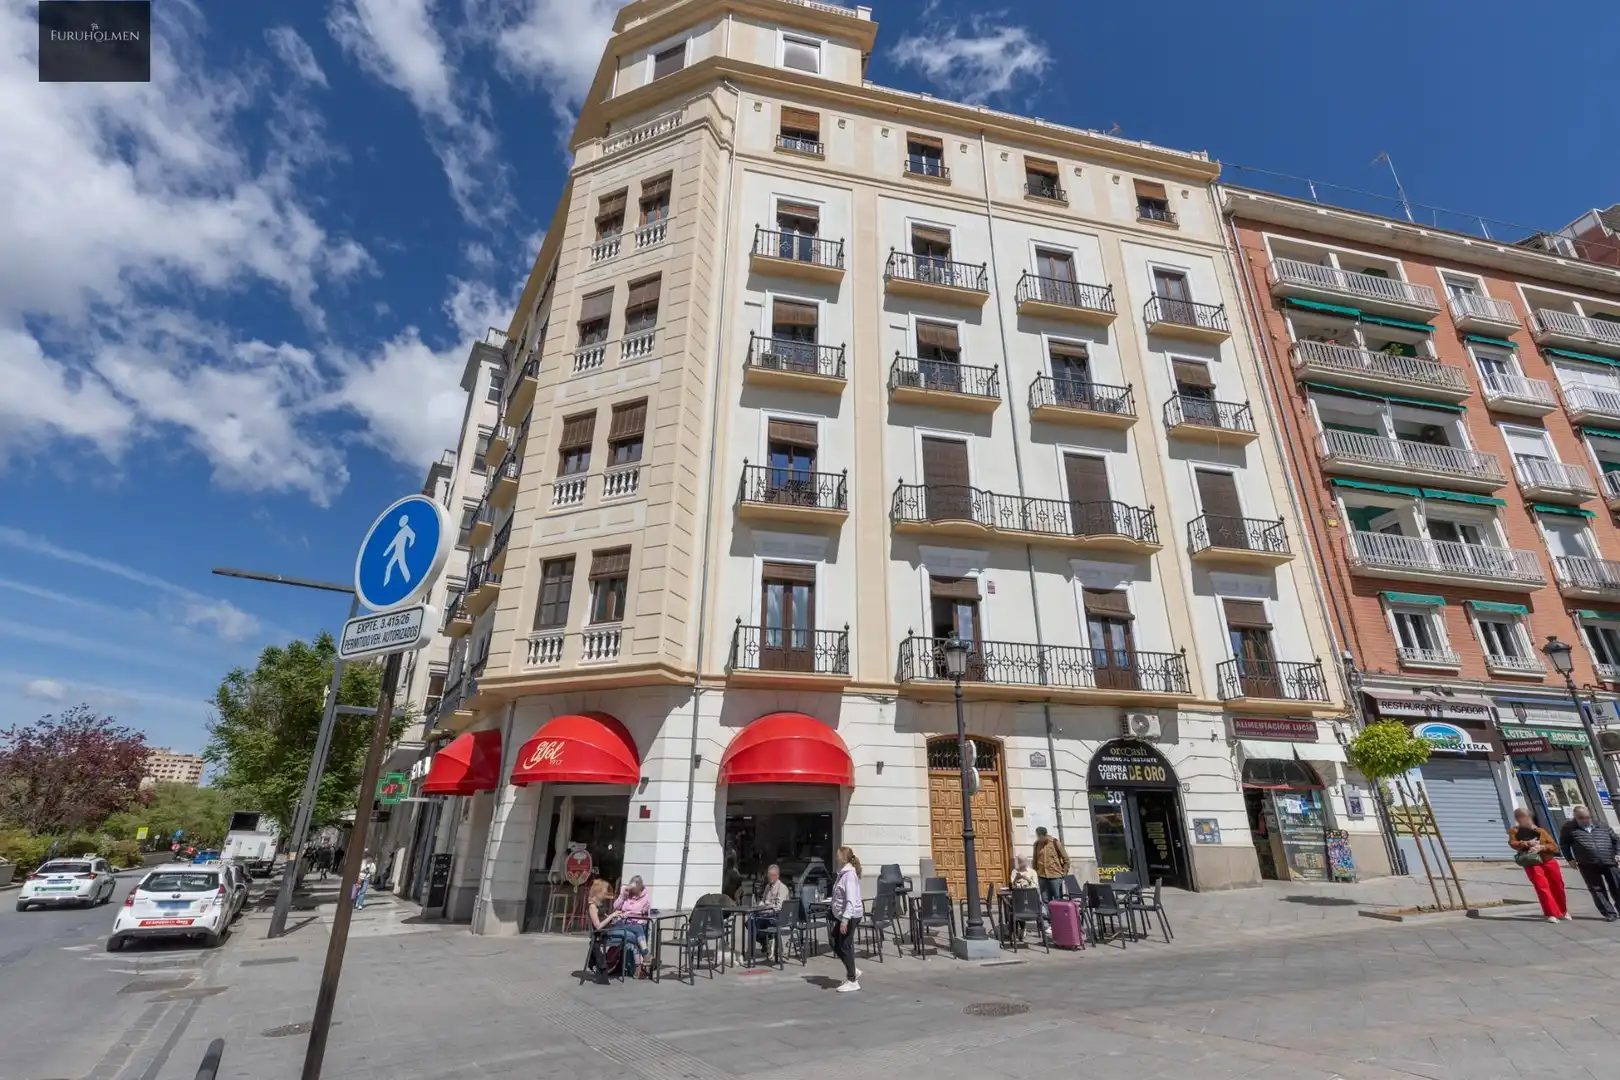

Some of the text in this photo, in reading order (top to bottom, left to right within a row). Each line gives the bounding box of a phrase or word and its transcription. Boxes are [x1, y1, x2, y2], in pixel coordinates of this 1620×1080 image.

[356, 613, 411, 634] EXPTE. 3.415/26
[344, 634, 370, 650] PERMITIDO
[382, 625, 419, 642] AUTORIZADOS
[1381, 701, 1486, 715] RESTAURANTE ASADOR
[1235, 721, 1291, 731] ALIMENTACIÓN
[1550, 732, 1590, 743] BONOLOT
[1109, 746, 1148, 757] oroCash
[1098, 764, 1128, 773] COMPRA
[1128, 765, 1166, 782] DE ORO
[1100, 772, 1128, 780] VENTA
